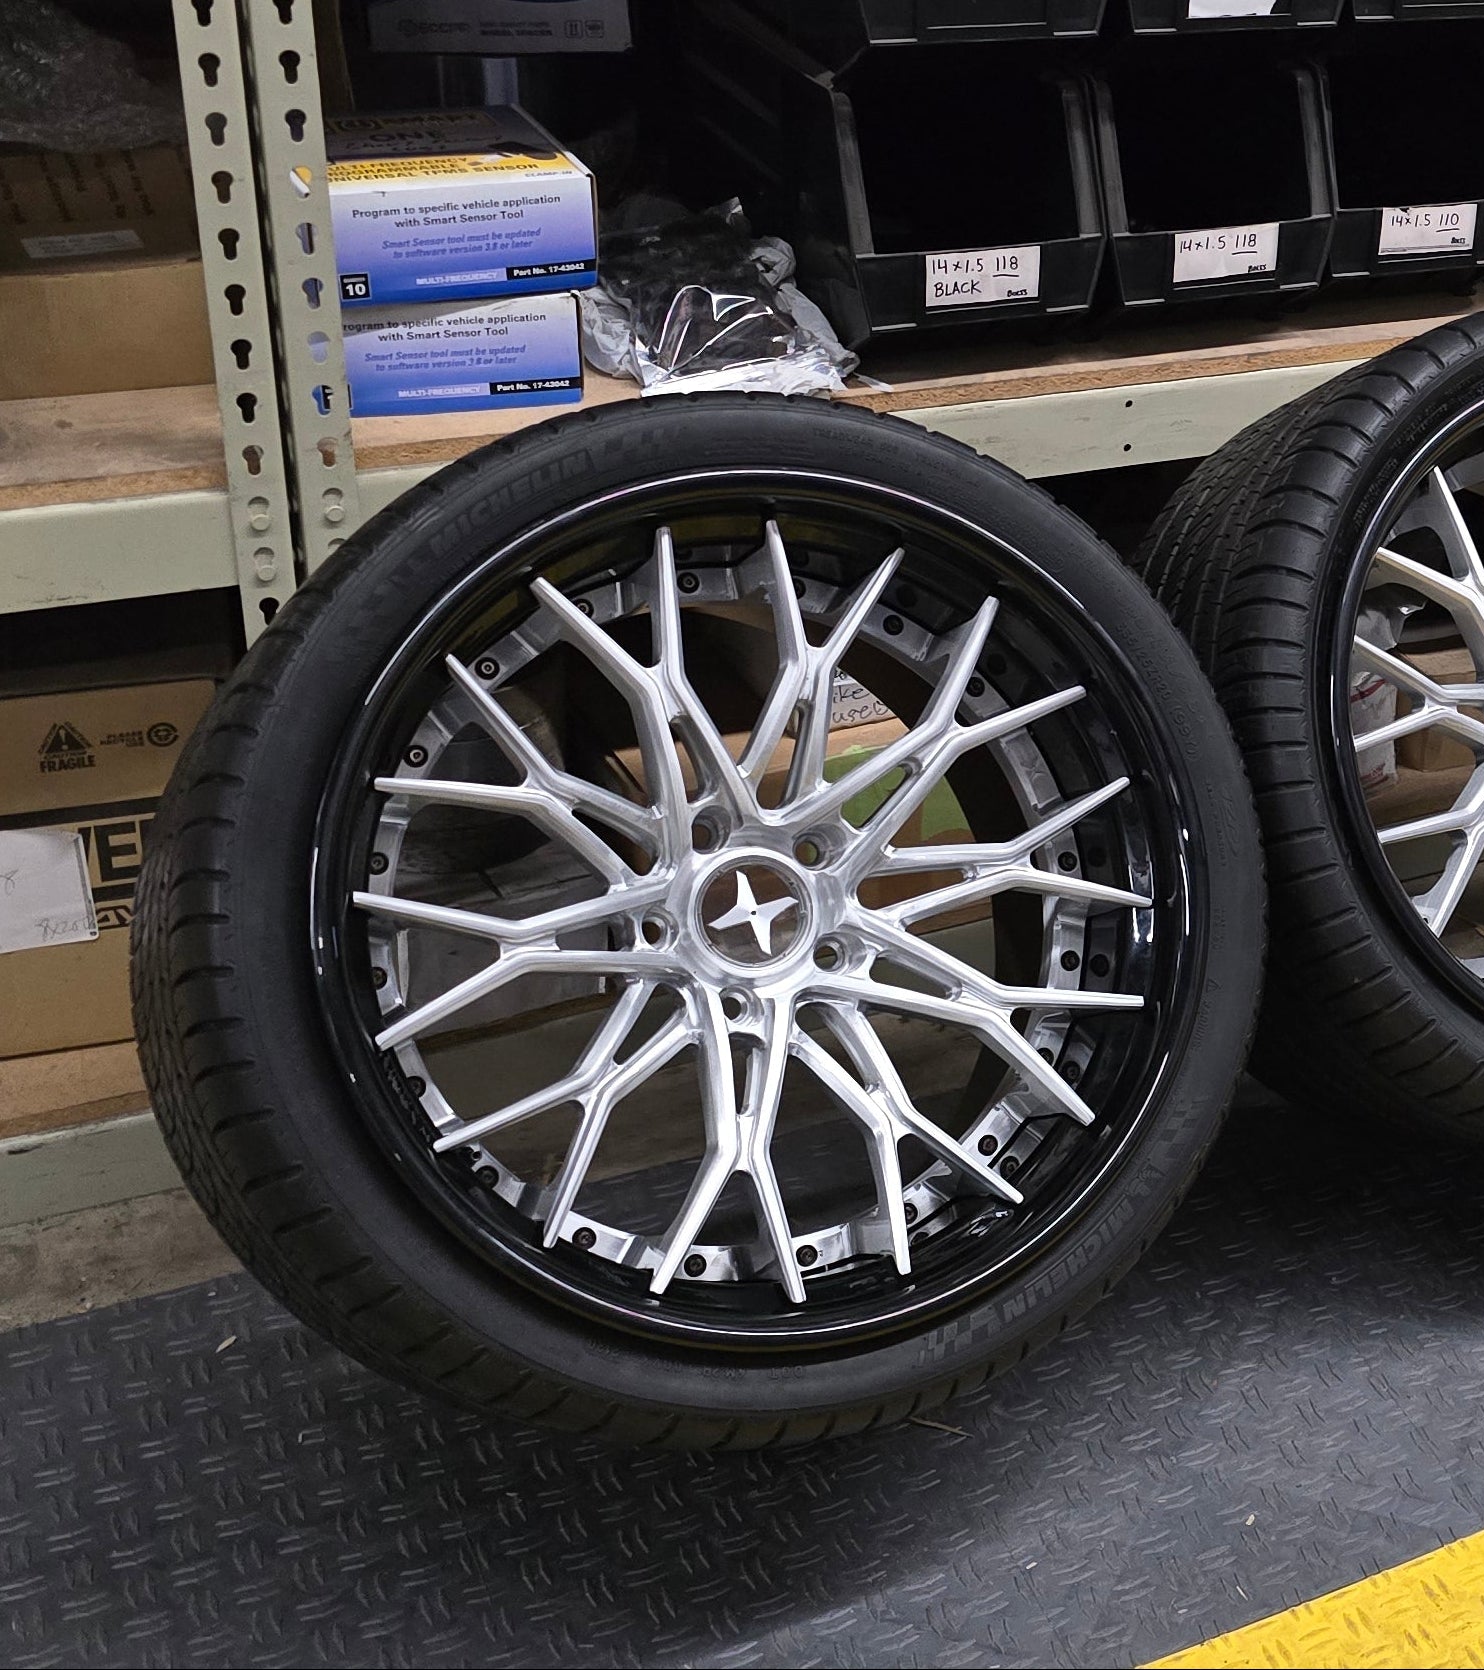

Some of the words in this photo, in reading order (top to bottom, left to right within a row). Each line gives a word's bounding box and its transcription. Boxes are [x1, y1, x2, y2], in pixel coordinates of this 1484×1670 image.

[327, 157, 468, 171] ULTI-FREQUENCY
[424, 167, 469, 178] TPMS
[473, 163, 539, 174] SENSOR
[352, 206, 400, 219] Program
[404, 206, 415, 215] to
[418, 202, 460, 217] specific
[462, 199, 500, 211] vehicle
[502, 194, 561, 211] application
[394, 216, 421, 228] with
[423, 214, 457, 226] Smart
[460, 212, 497, 223] Sensor
[499, 208, 524, 219] Tool
[1439, 213, 1460, 227] 110
[382, 239, 410, 250] Smart
[413, 236, 445, 247] Sensor
[447, 233, 465, 244] tool
[467, 232, 490, 243] must
[491, 231, 503, 241] be
[505, 226, 542, 242] updated
[1235, 234, 1257, 249] 118
[405, 246, 447, 259] software
[449, 244, 483, 256] version
[499, 241, 510, 250] or
[512, 238, 533, 248] later
[513, 268, 531, 277] Part
[532, 266, 547, 276] No.
[996, 255, 1019, 271] 118
[416, 272, 498, 285] MULTI-FREQUENCY
[345, 284, 366, 297] 10
[934, 279, 982, 297] BLACK
[343, 321, 385, 333] rogram
[388, 319, 399, 329] to
[402, 316, 444, 330] specific
[446, 314, 484, 326] vehicle
[487, 312, 547, 327] application
[378, 331, 404, 342] with
[406, 329, 440, 341] Smart
[443, 327, 481, 338] Sensor
[484, 326, 508, 337] Tool
[365, 351, 393, 363] Smart
[395, 350, 428, 361] Sensor
[430, 348, 448, 359] tool
[450, 347, 473, 357] must
[475, 346, 487, 356] be
[489, 344, 527, 358] updated
[388, 360, 429, 372] software
[432, 358, 466, 369] version
[483, 357, 494, 365] or
[495, 355, 517, 365] later
[398, 385, 481, 398] MULTI-FREQUENCY
[497, 383, 515, 392] Part
[517, 382, 531, 391] No.
[430, 450, 595, 554] MICHELIN
[833, 684, 870, 703] ike
[40, 755, 97, 773] FRAGILE
[1002, 1198, 1136, 1324] MICHELIN
